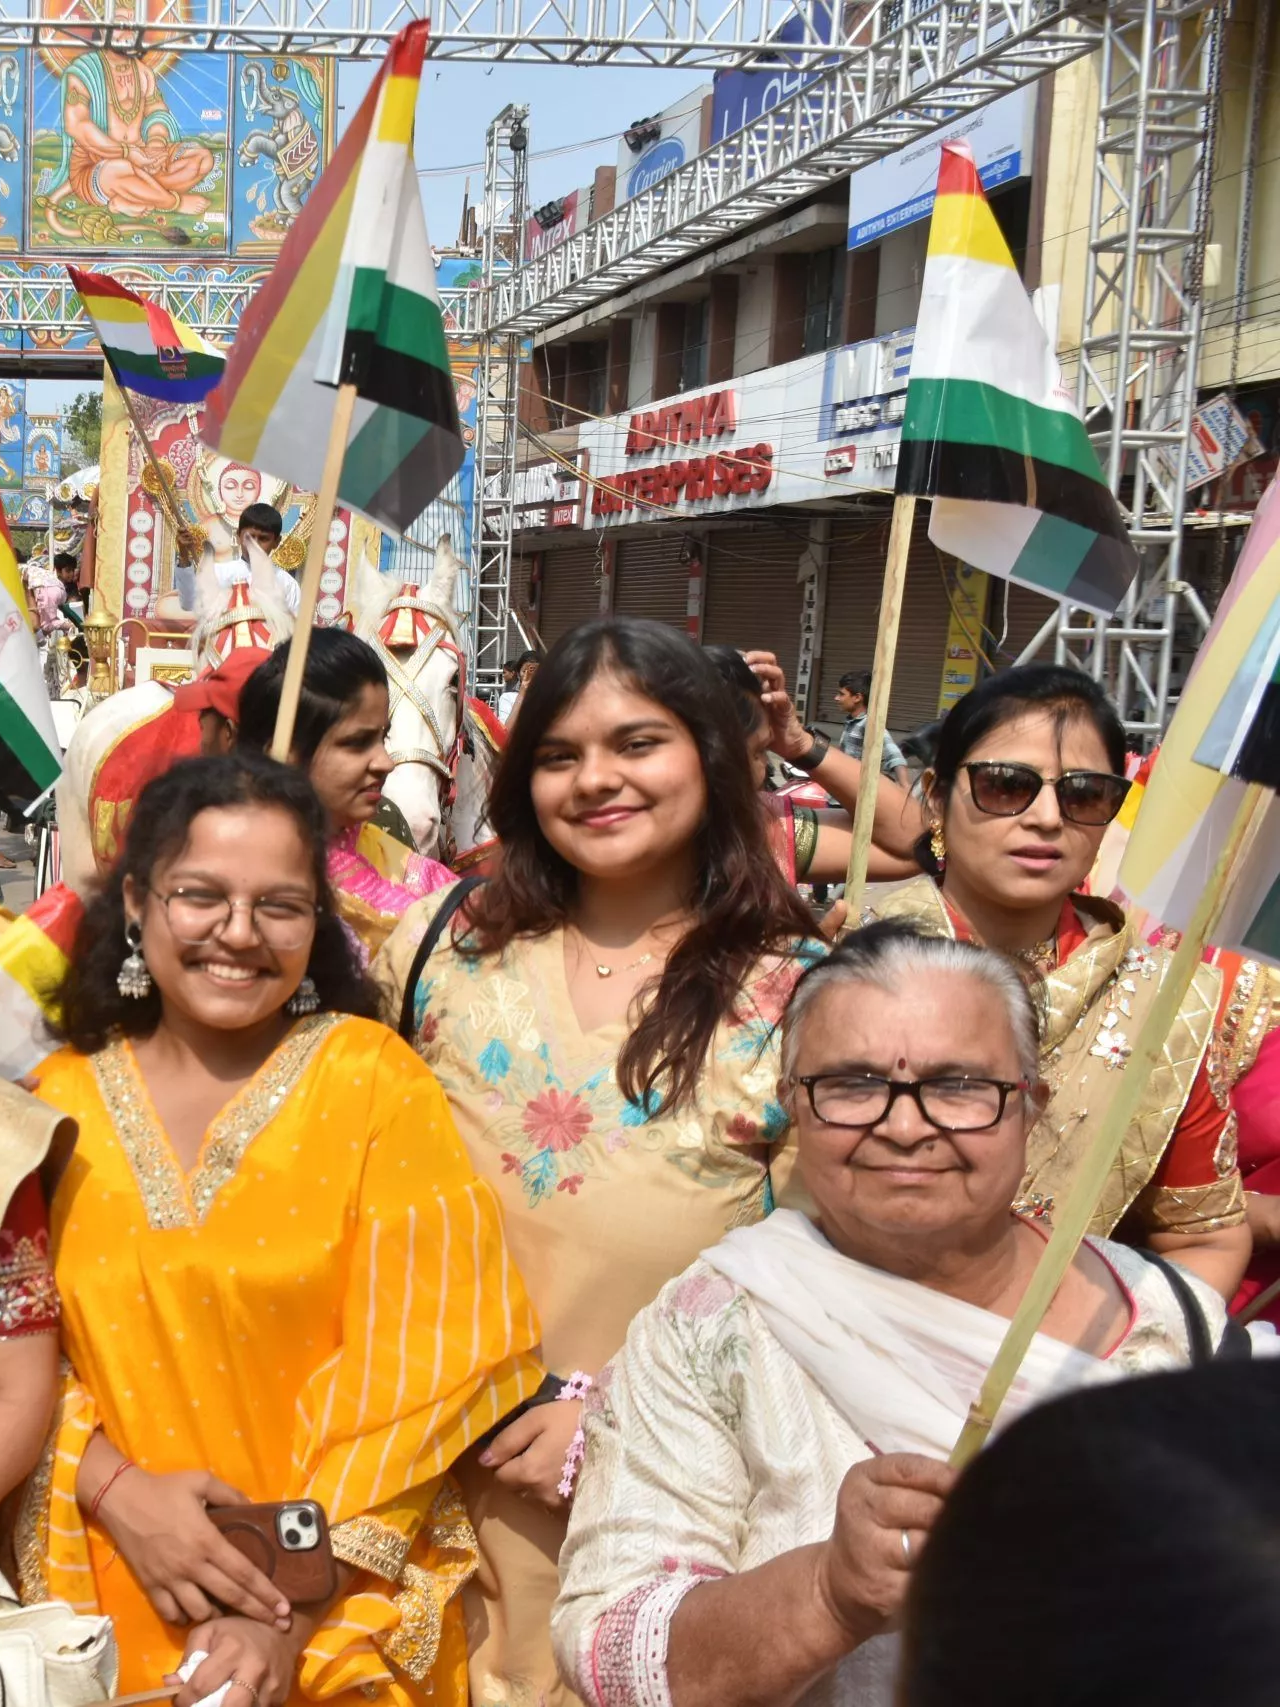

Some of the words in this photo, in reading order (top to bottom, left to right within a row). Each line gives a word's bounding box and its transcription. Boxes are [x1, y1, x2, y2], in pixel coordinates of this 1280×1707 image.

[634, 155, 677, 195] Carrier
[625, 389, 736, 455] ADITHYA
[592, 442, 773, 515] ENTERPRISES
